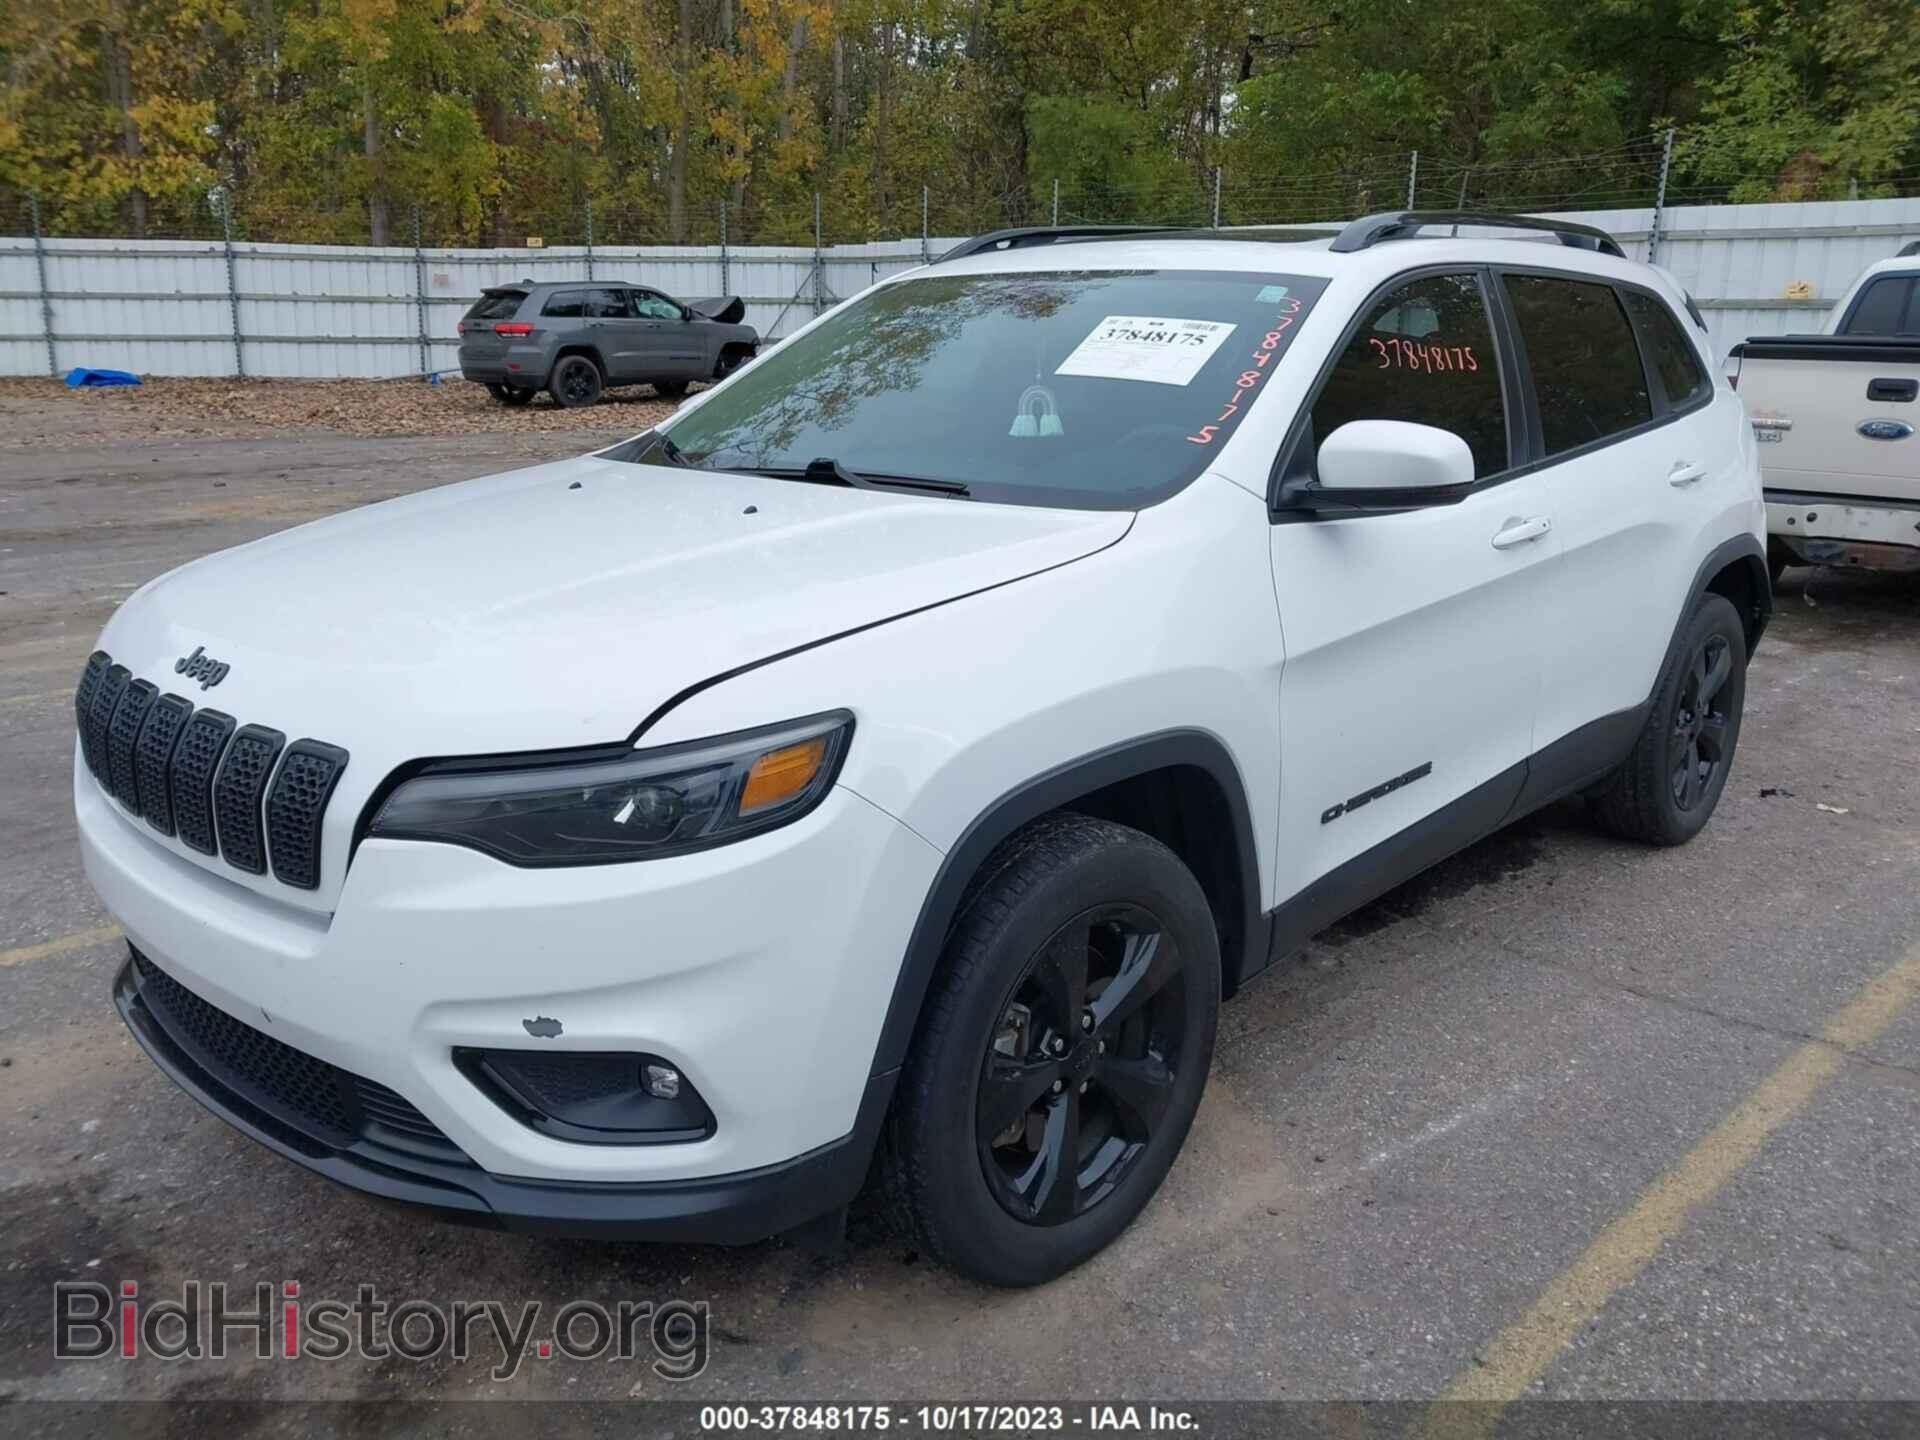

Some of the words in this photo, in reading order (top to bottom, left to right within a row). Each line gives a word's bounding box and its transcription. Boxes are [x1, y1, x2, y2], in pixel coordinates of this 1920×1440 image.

[1100, 328, 1208, 346] 37848175
[1369, 338, 1478, 374] 37848175
[1186, 296, 1301, 444] 37848175
[174, 646, 230, 691] Jeep
